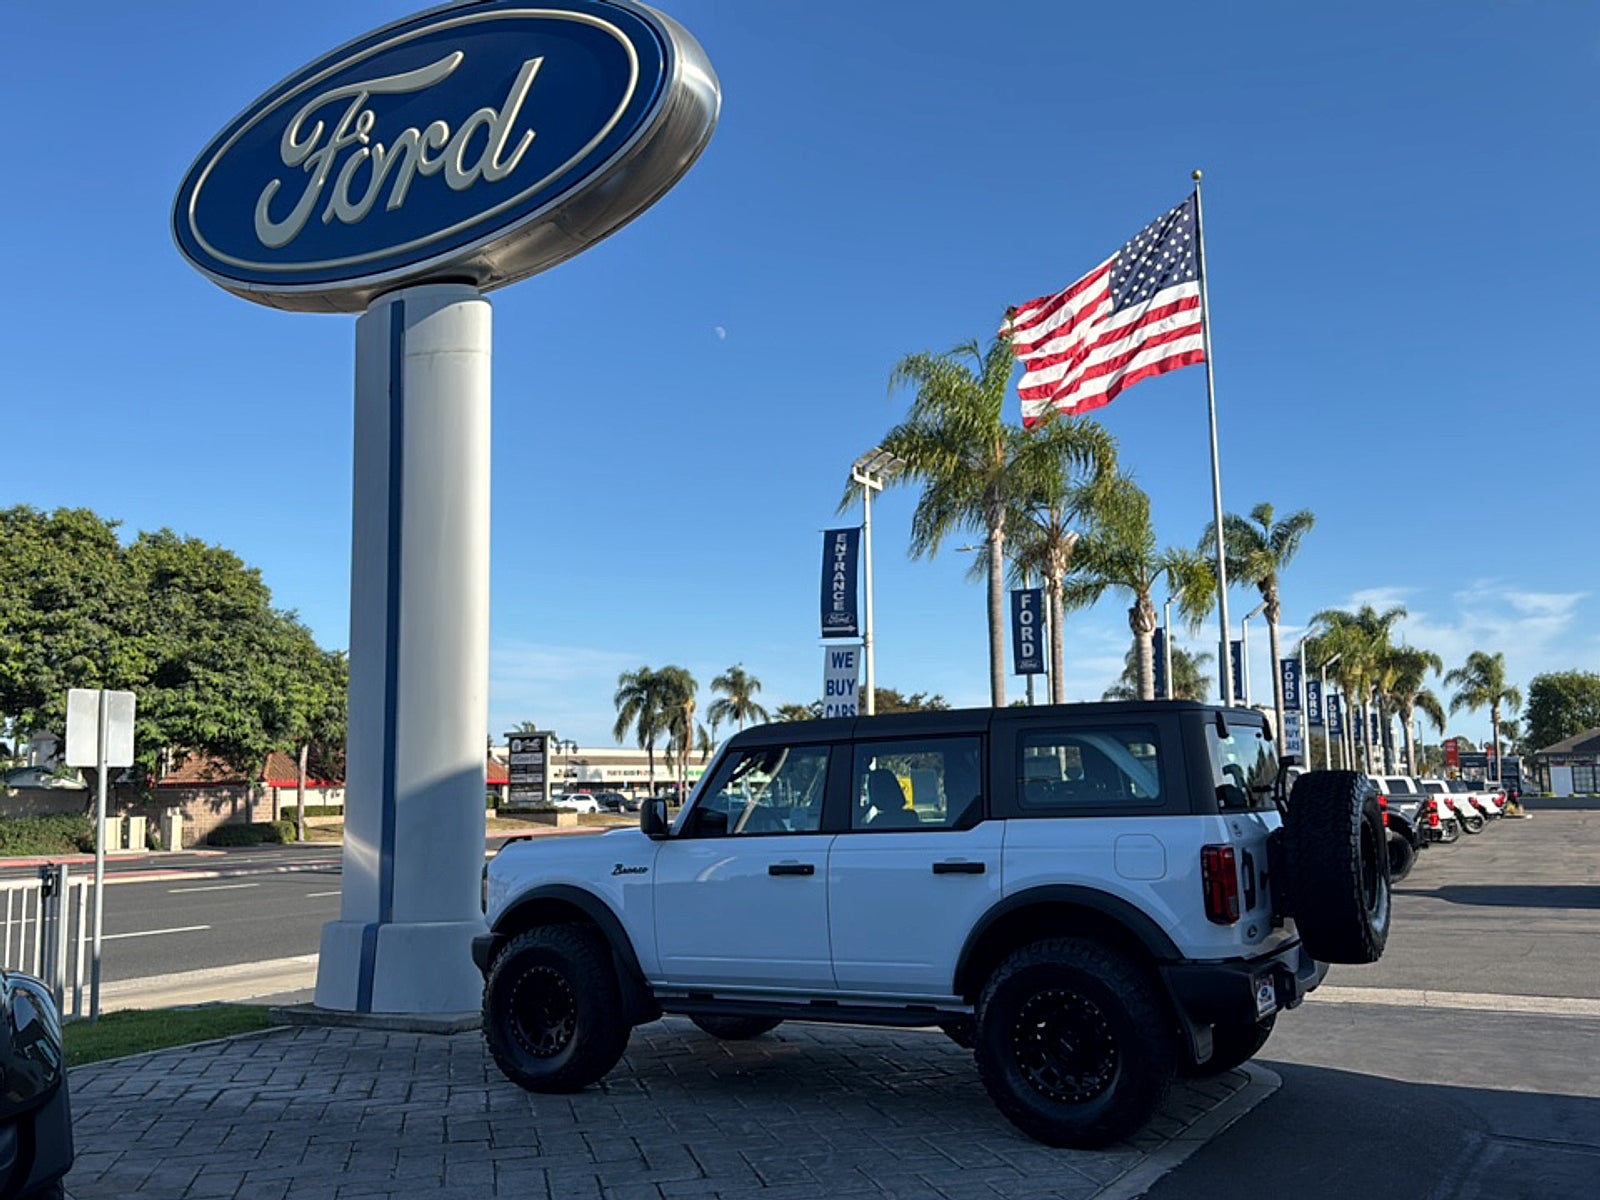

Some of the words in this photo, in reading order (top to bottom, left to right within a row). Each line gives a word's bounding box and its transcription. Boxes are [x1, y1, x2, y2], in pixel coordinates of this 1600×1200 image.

[254, 50, 544, 248] Ford
[832, 533, 847, 611] ENTRANCE
[1020, 593, 1035, 658] FORD
[831, 651, 854, 669] WE
[826, 678, 856, 696] BUY
[1283, 661, 1295, 700] FORD
[826, 703, 856, 718] CARS
[1308, 682, 1318, 718] FORD
[1328, 696, 1338, 727] FORD
[611, 863, 648, 876] Bronco
